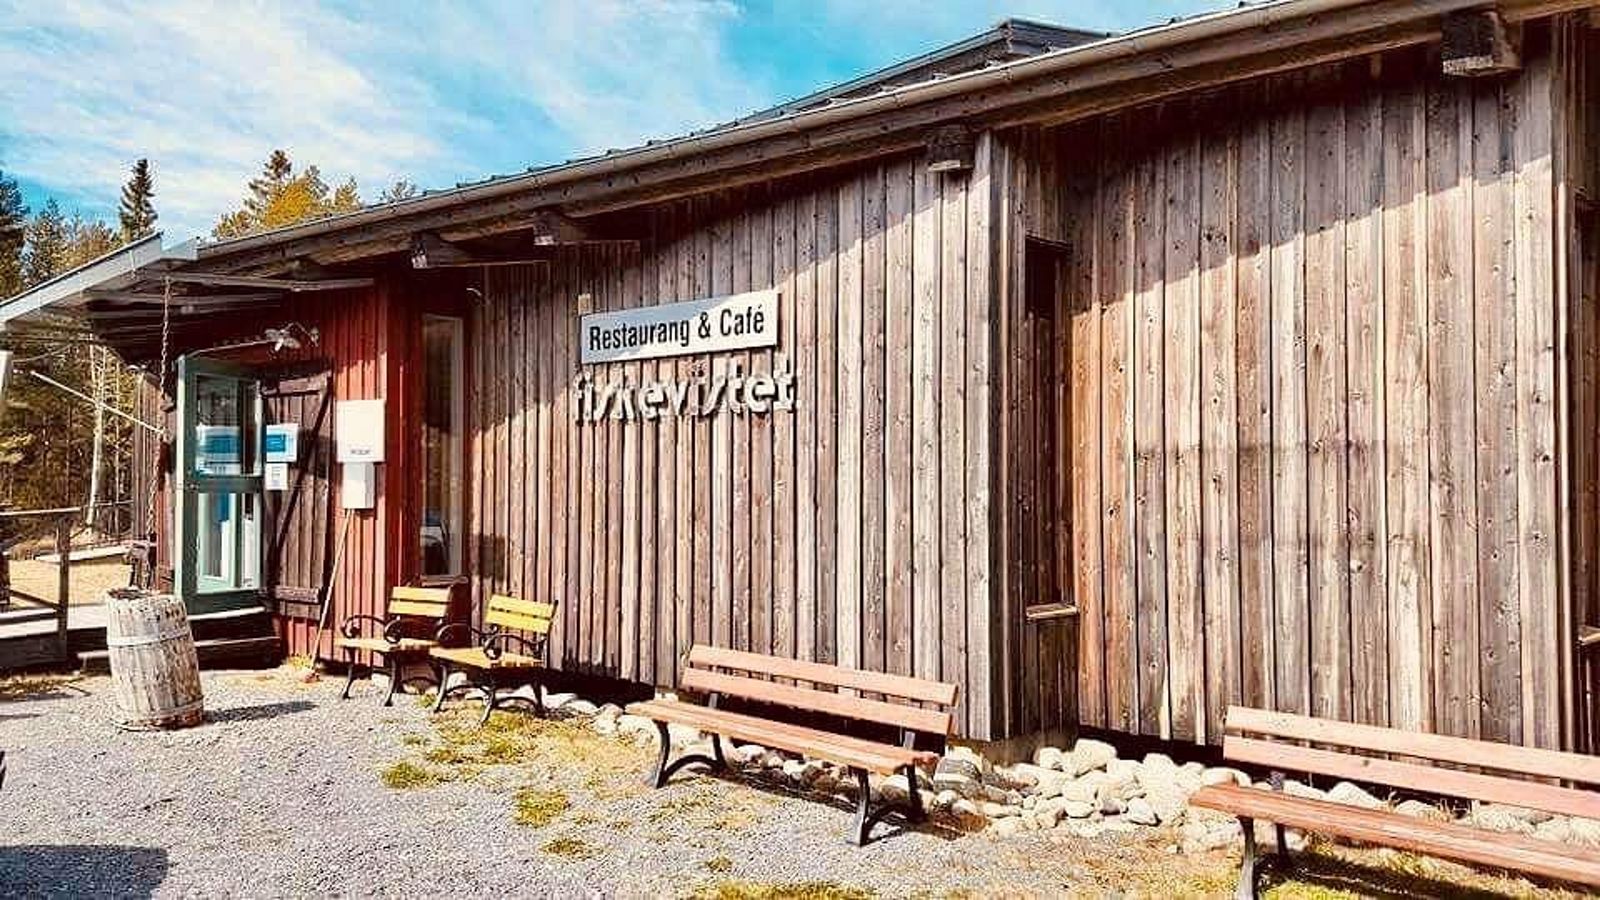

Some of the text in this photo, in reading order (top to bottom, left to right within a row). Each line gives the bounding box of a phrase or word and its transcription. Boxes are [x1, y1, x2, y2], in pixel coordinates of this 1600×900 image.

[589, 304, 764, 351] Restaurang & Café
